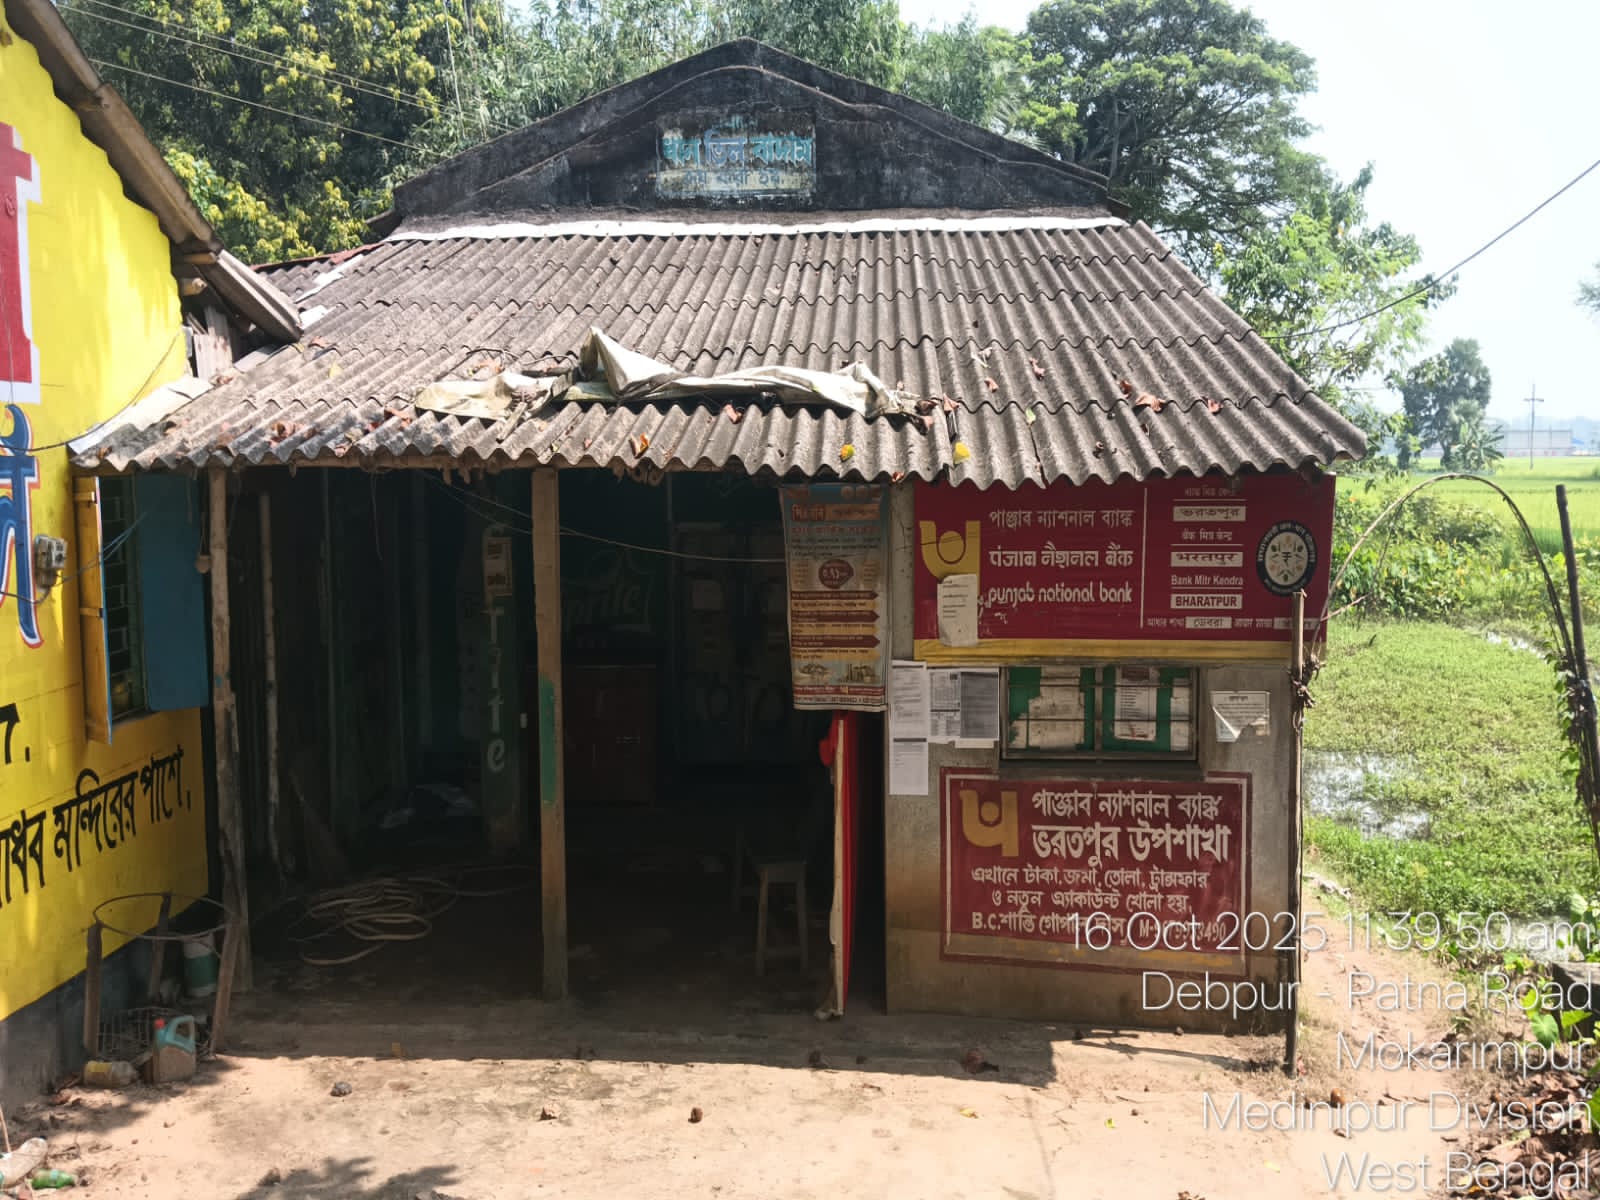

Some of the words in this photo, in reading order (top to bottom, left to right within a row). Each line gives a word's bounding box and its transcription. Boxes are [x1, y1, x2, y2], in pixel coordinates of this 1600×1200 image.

[989, 508, 1033, 531] পাঞ্জাব
[1037, 508, 1096, 529] ন্যাশনাল
[1101, 508, 1135, 530] ব্যাঙ্ক
[989, 545, 1037, 569] पंजाब
[1040, 541, 1100, 570] नैशनल
[1105, 542, 1134, 569] बैंक
[1171, 574, 1192, 586] Bank
[1194, 575, 1210, 586] Mitr
[1212, 575, 1244, 587] Kendra
[987, 580, 1035, 608] punjab
[1038, 581, 1096, 603] national
[1100, 580, 1133, 603] bank
[1174, 595, 1238, 608] BHARATPUR
[1032, 788, 1092, 818] পাঞ্জাব
[1098, 790, 1171, 822] ন্যাশনাল
[1176, 792, 1223, 823] ব্যাঙ্ক
[53, 767, 139, 873] মন্দিরের
[1031, 822, 1121, 868] ভরতপুর
[1127, 818, 1232, 864] উপশাখা
[971, 865, 1019, 887] এখানে
[991, 889, 1002, 908] ও
[1006, 889, 1045, 914] নতুন
[1126, 891, 1165, 913] খোলা
